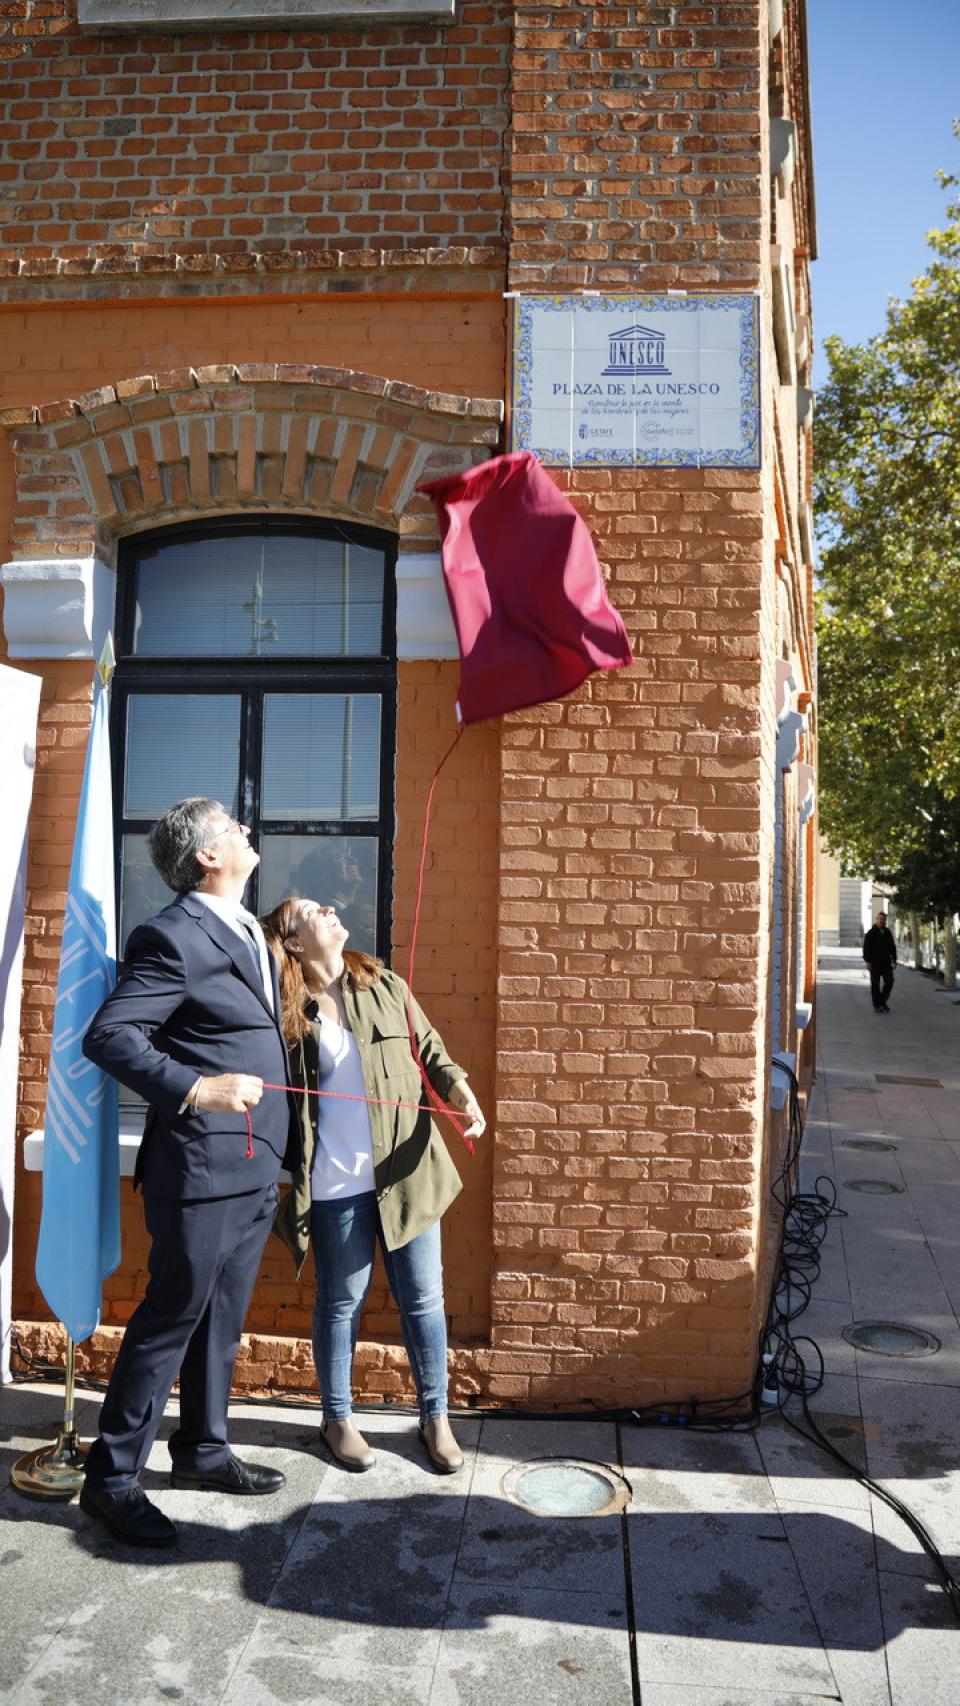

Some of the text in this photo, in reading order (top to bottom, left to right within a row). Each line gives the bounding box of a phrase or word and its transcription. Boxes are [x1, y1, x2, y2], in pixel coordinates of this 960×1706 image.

[609, 341, 665, 365] UNESCO
[552, 383, 720, 396] PLAZA DE LA UNESCO
